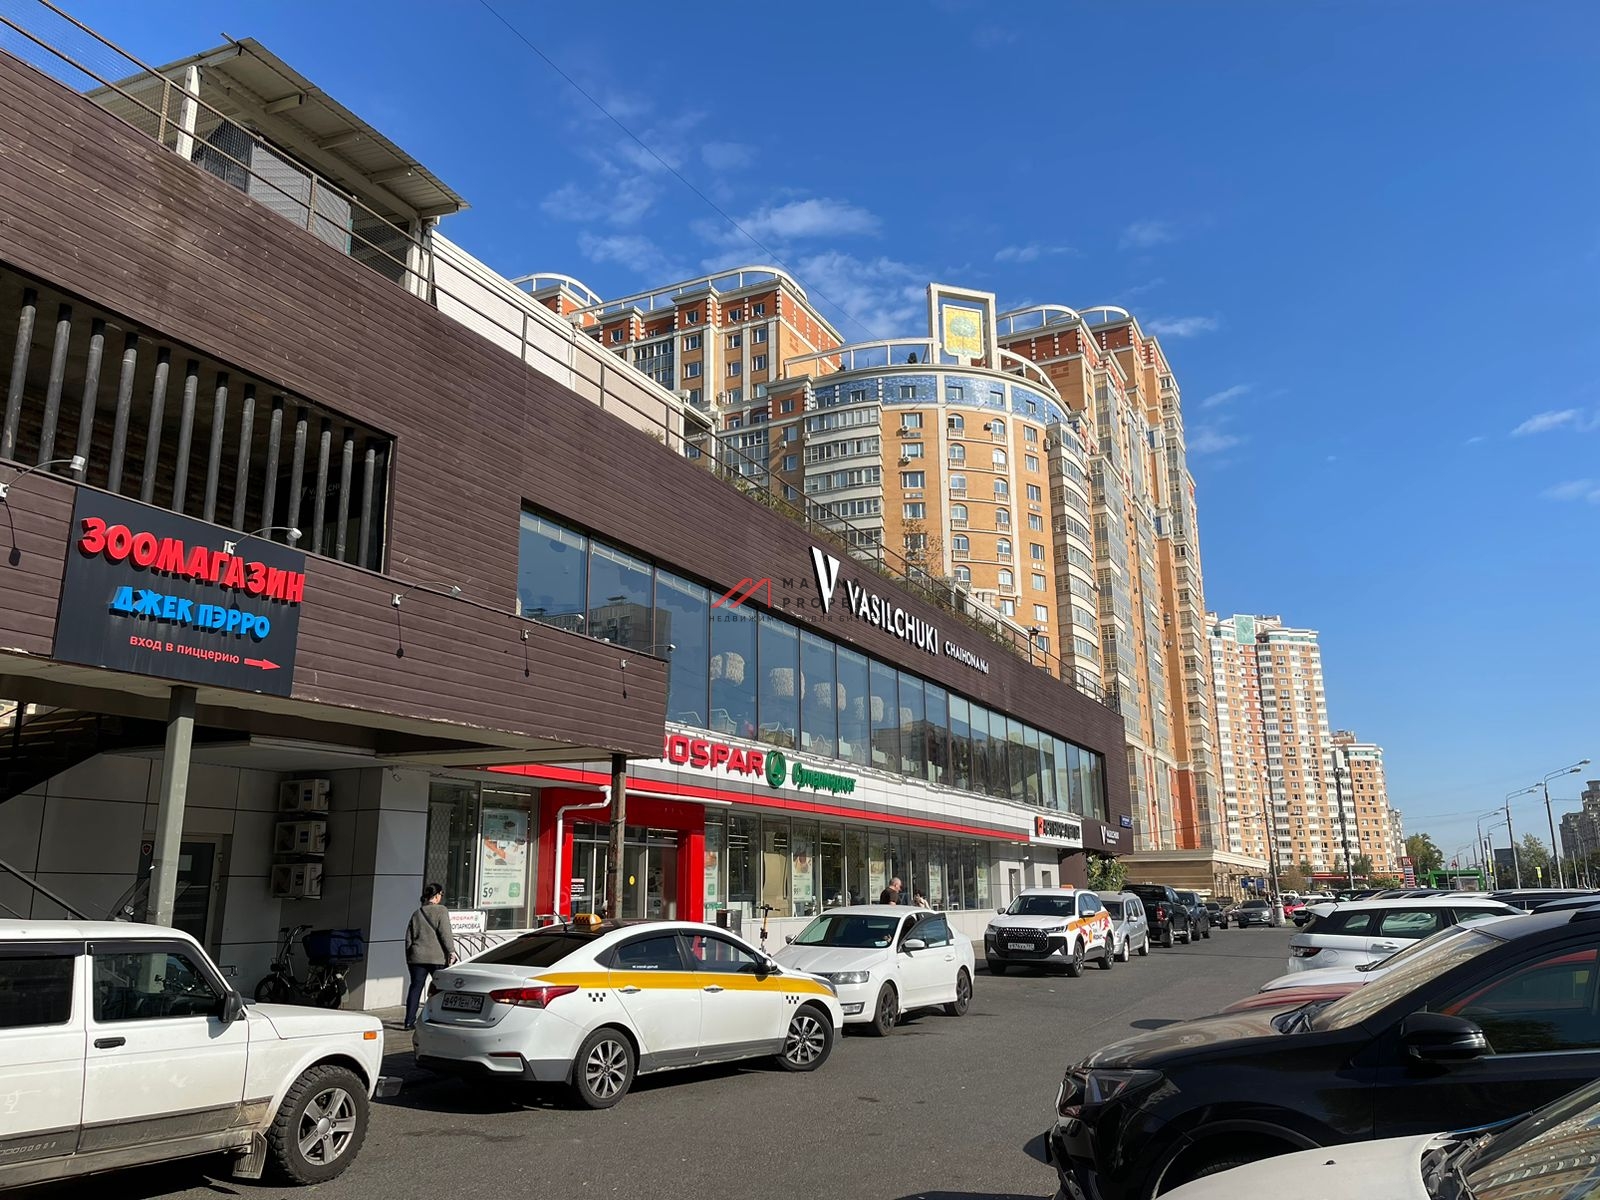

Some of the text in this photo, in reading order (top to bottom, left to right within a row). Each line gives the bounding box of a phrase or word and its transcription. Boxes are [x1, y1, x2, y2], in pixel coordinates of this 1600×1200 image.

[79, 517, 305, 603] ЗООМАГАЗИН
[111, 586, 271, 640] ДЖЕК ПЭРРО
[846, 580, 939, 655] VASILCHUKI
[945, 640, 980, 670] CHAIHONA
[129, 635, 241, 666] вход в пиццерию
